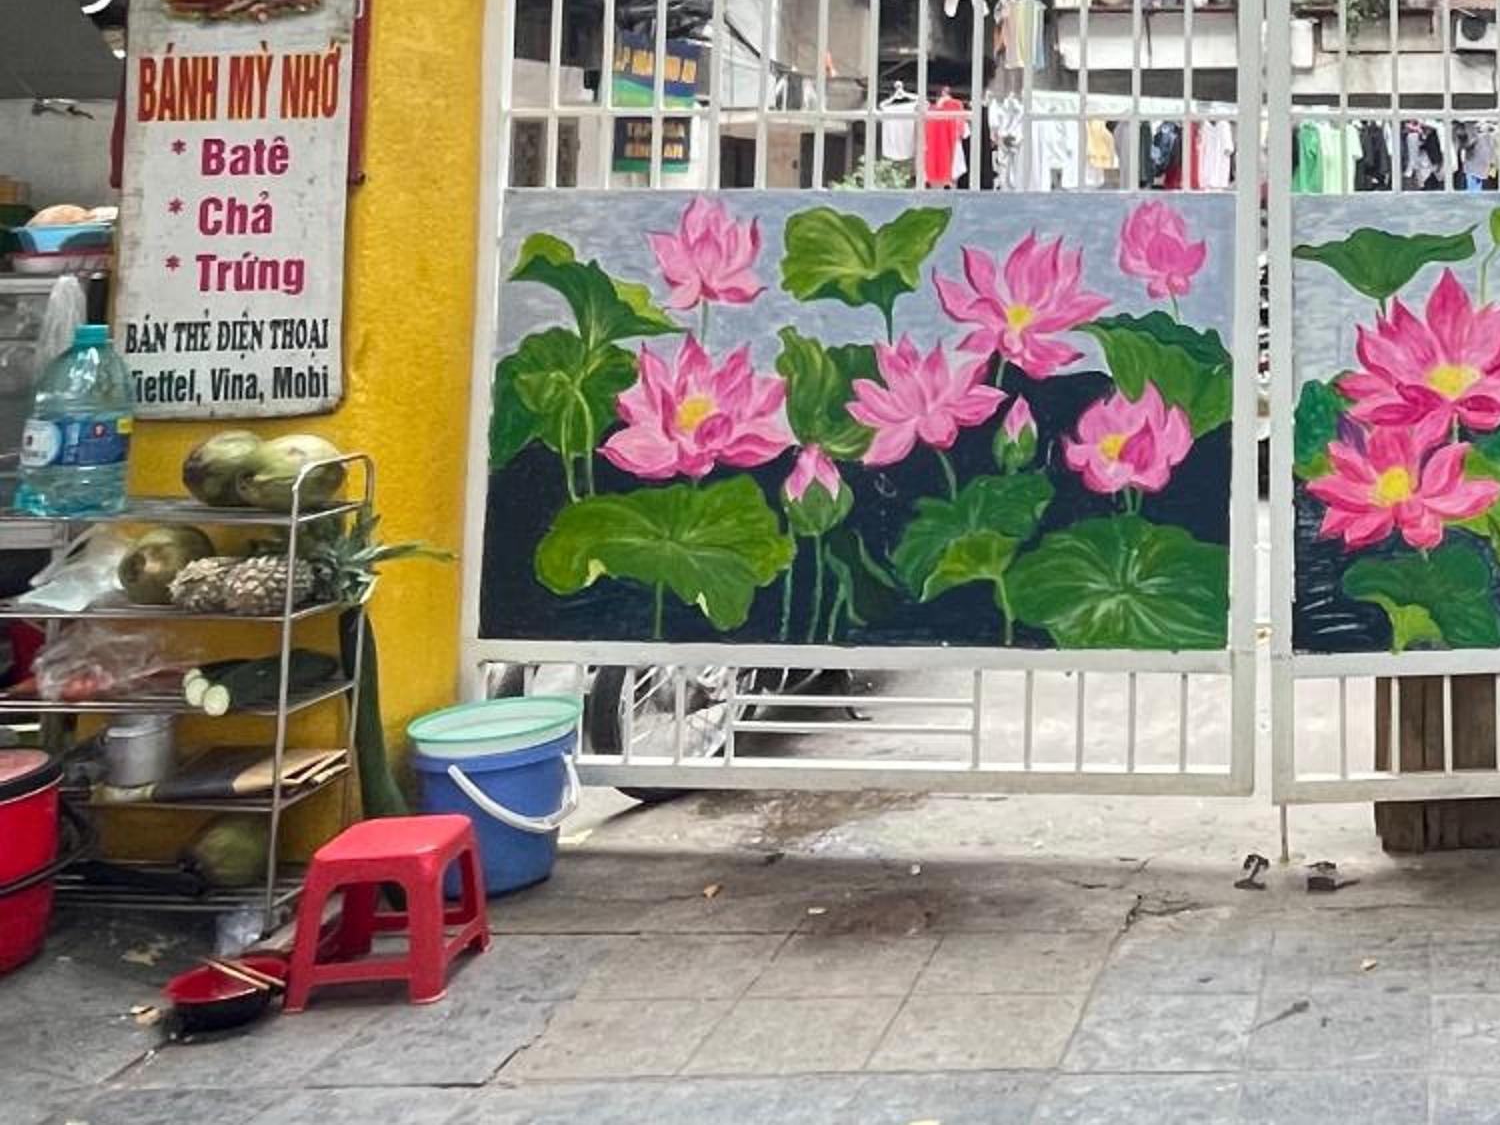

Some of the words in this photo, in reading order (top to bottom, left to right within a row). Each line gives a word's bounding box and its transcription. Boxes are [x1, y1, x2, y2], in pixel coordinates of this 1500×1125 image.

[137, 42, 219, 122] BÁNH
[227, 40, 274, 120] MỲ
[280, 36, 342, 119] NHỚ
[201, 136, 290, 176] Batê
[197, 190, 274, 236] Chả
[196, 251, 306, 296] Trứng
[125, 313, 169, 354] BÁN
[173, 308, 212, 352] THẺ
[216, 310, 265, 360] ĐIỆN
[270, 318, 330, 358] THOẠI
[131, 368, 202, 406] iettel,
[210, 367, 265, 404] Vina,
[272, 364, 330, 400] Mobi
